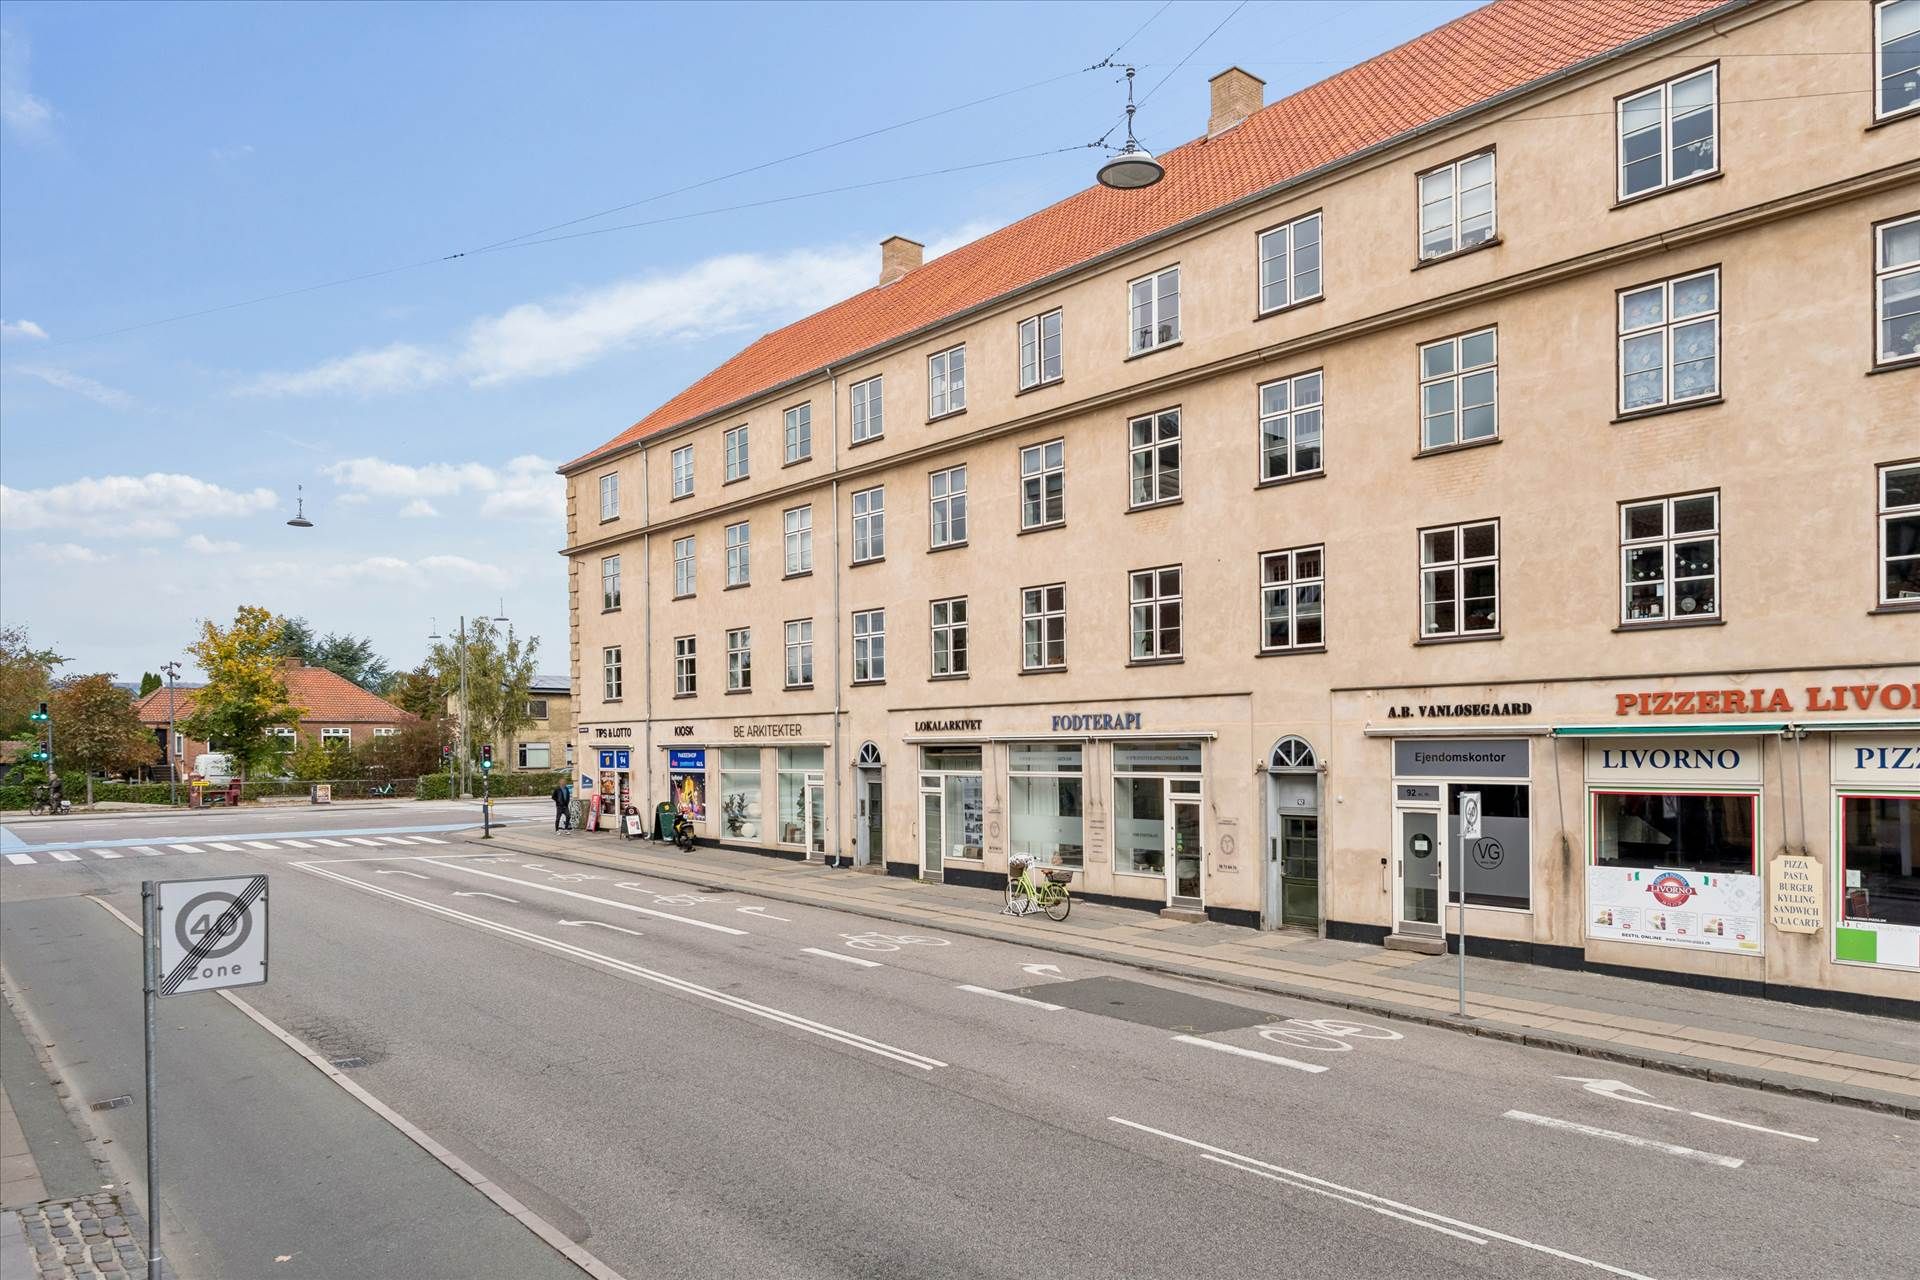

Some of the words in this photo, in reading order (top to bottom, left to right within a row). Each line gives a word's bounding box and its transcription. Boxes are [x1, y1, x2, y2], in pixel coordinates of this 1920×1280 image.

[1615, 688, 1794, 716] PIZZERIA
[1388, 706, 1414, 718] A.B.
[1419, 702, 1532, 718] VANLØSEGAARD
[915, 719, 982, 732] LOKALARKIVET
[1052, 712, 1142, 731] FODTERAPI
[595, 728, 607, 738] TIPS
[608, 728, 612, 737] &
[613, 727, 632, 738] LOTTO
[674, 725, 694, 736] KIOSK
[733, 725, 745, 738] BE
[747, 723, 802, 737] ARKITEKTER
[1415, 752, 1506, 764] Ejendomskontor
[1602, 748, 1740, 769] LIVORNO
[1855, 747, 1920, 769] PIZ
[1406, 788, 1417, 797] 92
[1477, 843, 1500, 860] VG
[1783, 860, 1809, 869] PIZZA
[1783, 871, 1809, 880] PASTA
[1650, 885, 1692, 895] LIVORNO
[1779, 882, 1813, 892] BURGER
[1777, 893, 1815, 904] KYLLING
[1773, 905, 1819, 916] SANDWICH
[190, 913, 238, 937] 40
[1793, 918, 1821, 928] CARTE
[187, 964, 242, 981] Zone
